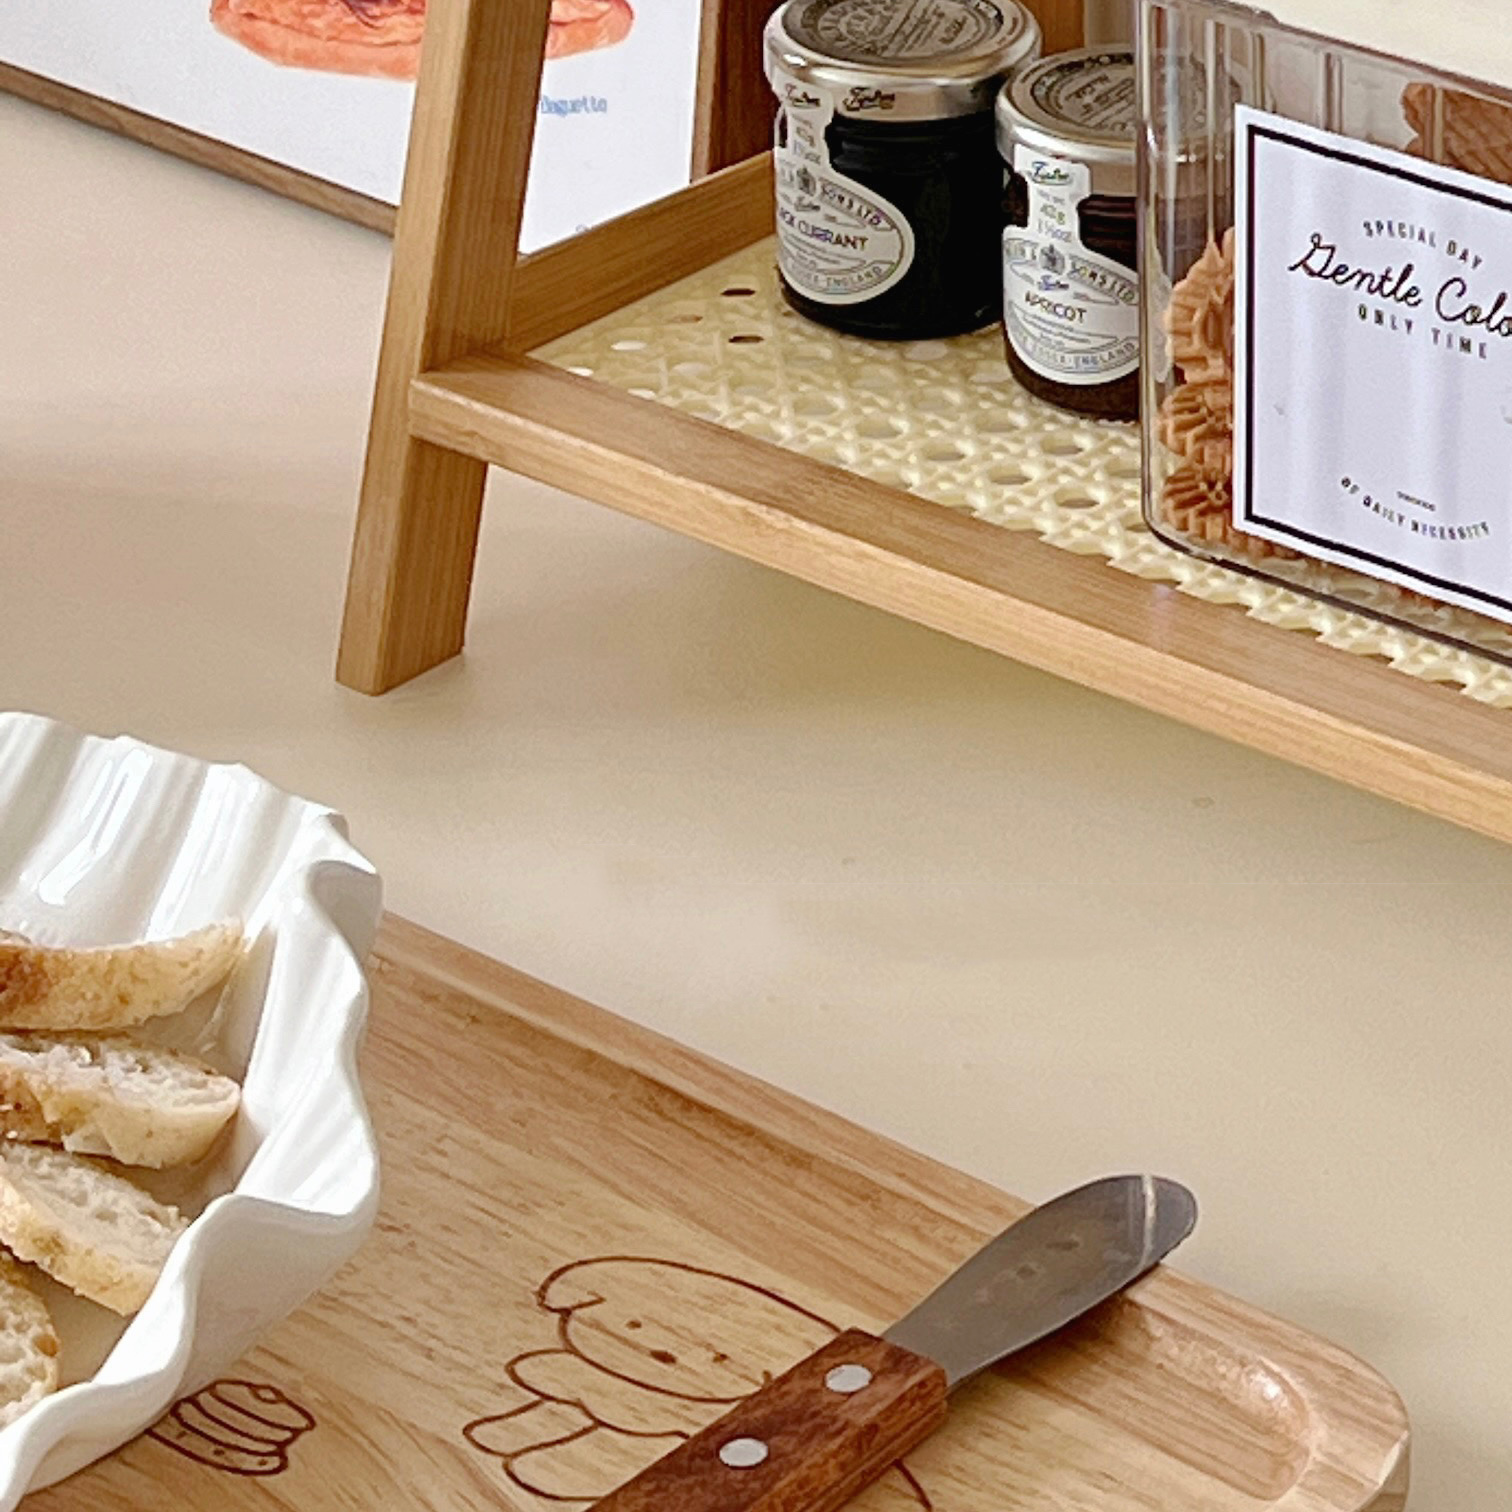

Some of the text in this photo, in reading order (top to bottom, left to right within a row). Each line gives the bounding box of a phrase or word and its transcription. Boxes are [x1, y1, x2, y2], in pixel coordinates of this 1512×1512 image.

[798, 220, 868, 252] CURRANT
[1363, 220, 1484, 271] SPECIAL DAY
[1288, 233, 1424, 307] Gentle
[1025, 290, 1086, 324] APRICOT
[1357, 303, 1489, 360] ONLY TIME
[1363, 495, 1405, 527] DAILY
[1411, 521, 1490, 540] NECESSITY
